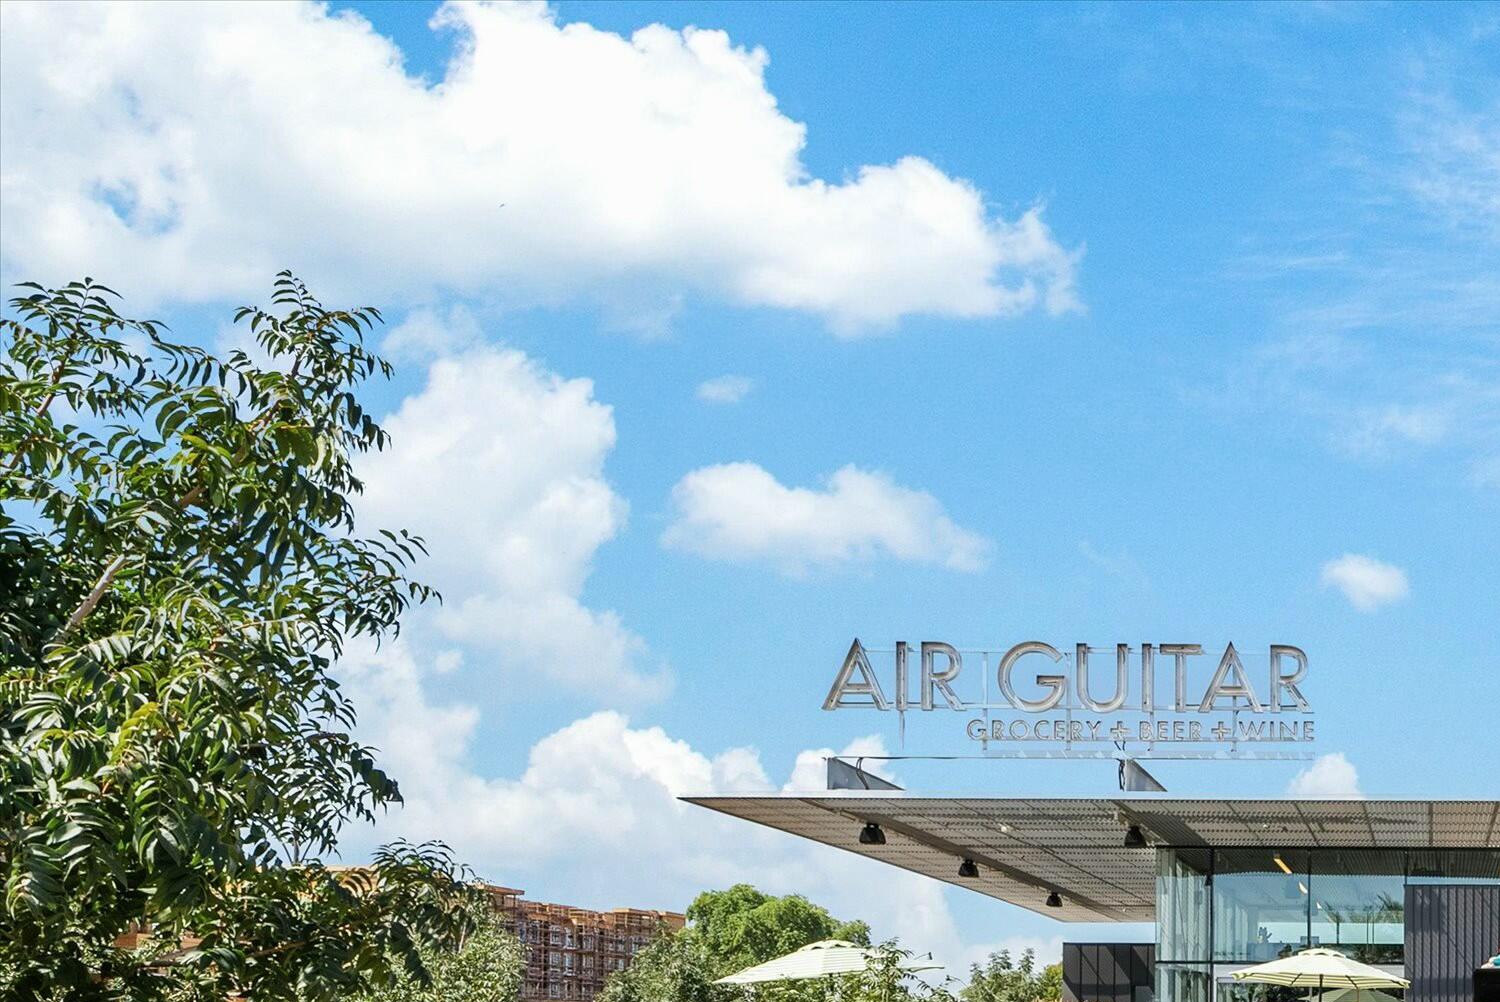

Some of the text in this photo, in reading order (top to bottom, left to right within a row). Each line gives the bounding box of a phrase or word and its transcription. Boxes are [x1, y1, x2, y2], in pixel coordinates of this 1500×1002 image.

[821, 637, 1315, 714] AIR GUITAR
[967, 719, 1315, 742] GROCERY + BEER + WINE
